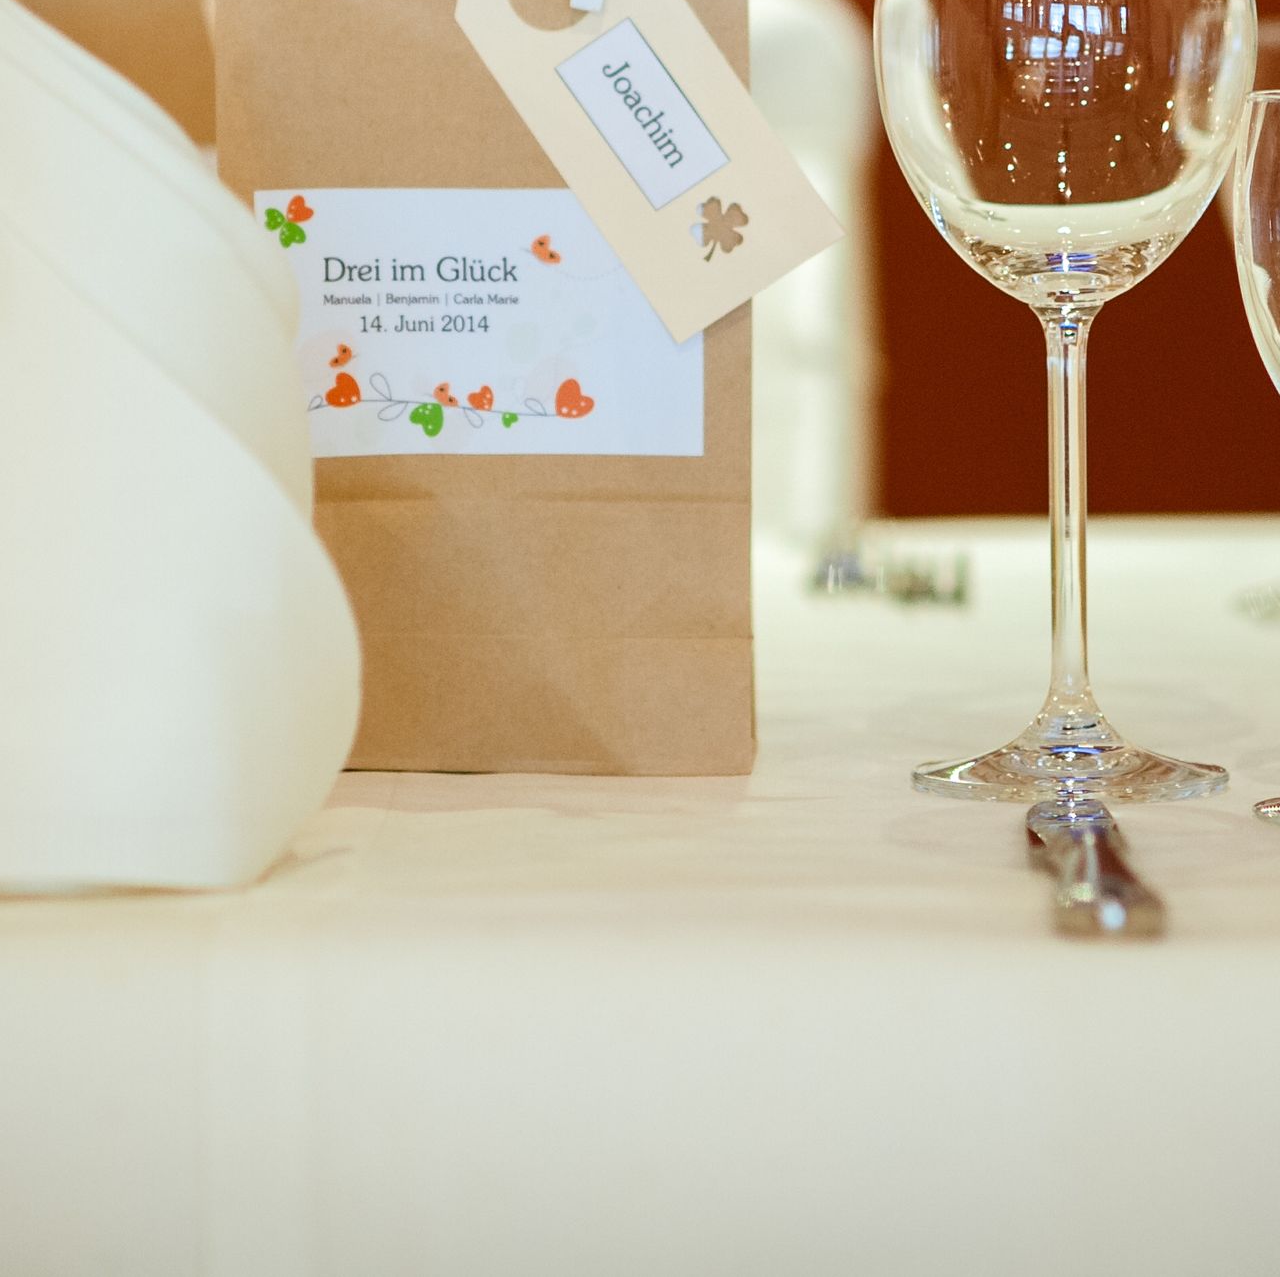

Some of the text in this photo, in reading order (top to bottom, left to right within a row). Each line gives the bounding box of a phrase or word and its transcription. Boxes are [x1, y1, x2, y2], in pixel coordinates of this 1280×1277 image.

[601, 61, 684, 169] Joachim
[323, 255, 518, 283] Drei im Glück
[323, 292, 520, 307] Manuela Benjamin Carla Marie
[360, 314, 490, 333] 14. Juni 2014
